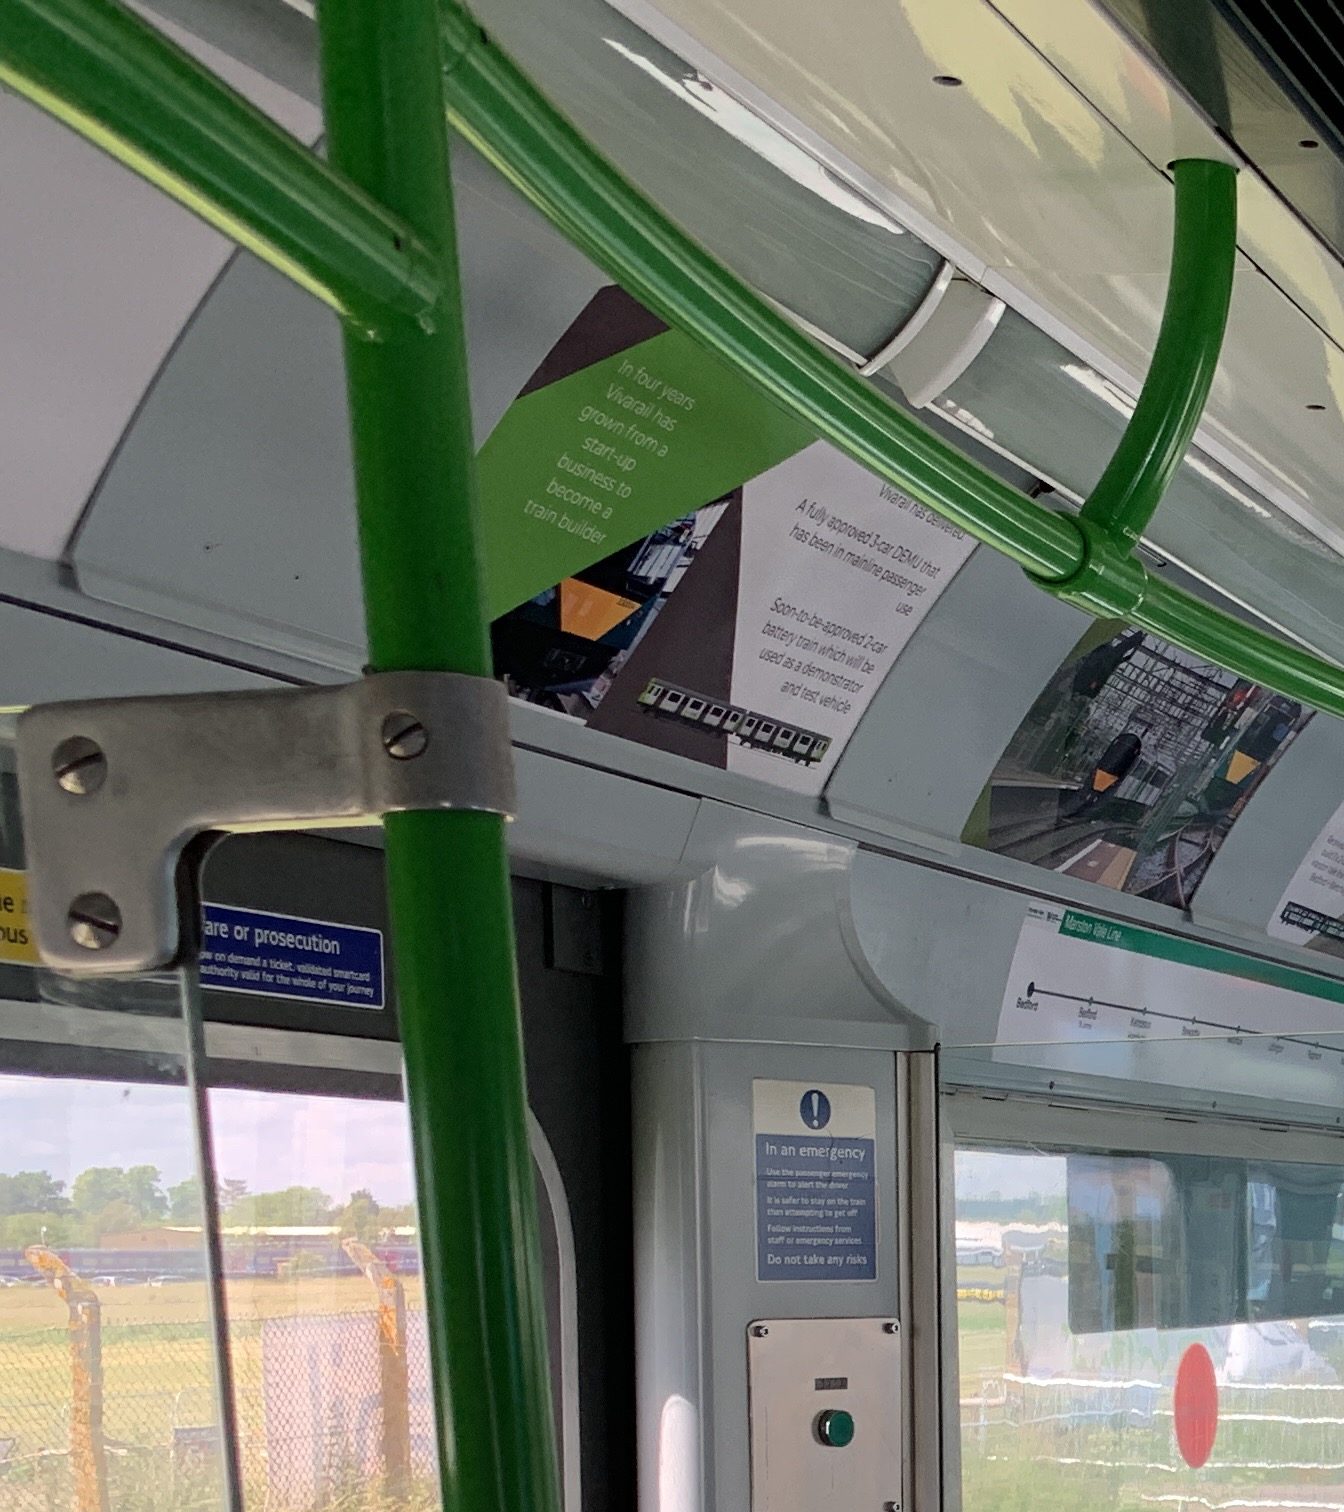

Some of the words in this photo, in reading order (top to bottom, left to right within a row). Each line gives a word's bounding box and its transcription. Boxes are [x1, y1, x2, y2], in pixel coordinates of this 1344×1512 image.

[618, 359, 633, 377] In
[634, 364, 662, 393] four
[659, 383, 697, 412] years
[606, 382, 652, 419] Vivarail
[653, 408, 678, 432] has
[578, 405, 625, 436] grown
[624, 423, 658, 452] from
[657, 444, 669, 458] a
[581, 436, 637, 473] start-up
[557, 451, 617, 491] business
[617, 479, 632, 499] to
[546, 478, 604, 514] become
[602, 506, 613, 521] a
[523, 499, 558, 524] train
[558, 513, 607, 546] builder
[795, 499, 807, 513] A
[805, 504, 828, 526] fully
[827, 515, 872, 548] approved
[870, 533, 894, 555] 3-car
[892, 545, 923, 571] DEMU
[922, 559, 941, 579] that
[789, 523, 810, 544] has
[808, 531, 833, 556] been
[832, 543, 845, 559] in
[844, 548, 887, 578] mainline
[879, 570, 927, 597] passenger
[770, 597, 866, 647] Soon-to-be-approved
[863, 633, 888, 655] 2-car
[895, 602, 914, 617] use
[761, 622, 797, 649] battery
[796, 634, 817, 654] train
[816, 642, 847, 665] which
[845, 654, 863, 670] will
[862, 660, 875, 675] be
[758, 648, 783, 668] used
[782, 658, 794, 671] as
[793, 663, 802, 673] a
[801, 663, 863, 694] demonstrator
[780, 681, 801, 699] and
[800, 688, 820, 707] test
[819, 694, 851, 715] vehicle
[202, 921, 228, 938] are
[234, 925, 249, 940] or
[254, 928, 340, 954] prosecution
[215, 952, 225, 962] on
[228, 953, 260, 966] demand
[241, 970, 260, 980] valid
[262, 972, 274, 982] for
[276, 974, 290, 985] the
[292, 976, 316, 988] whole
[318, 979, 327, 990] of
[328, 983, 346, 992] your
[347, 985, 374, 998] journey
[766, 1142, 777, 1155] In
[781, 1146, 795, 1156] an
[800, 1147, 865, 1162] emergency
[766, 1168, 780, 1176] Use
[832, 1172, 869, 1180] emergency
[781, 1196, 800, 1204] safer
[834, 1210, 846, 1218] get
[767, 1224, 792, 1232] Follow
[792, 1225, 834, 1233] instructions
[835, 1225, 852, 1233] from
[767, 1236, 785, 1244] staff
[795, 1237, 834, 1246] emergency
[834, 1237, 862, 1245] services
[767, 1254, 781, 1264] Do
[784, 1256, 801, 1264] not
[804, 1254, 825, 1264] take
[827, 1256, 844, 1266] any
[846, 1254, 867, 1264] risks
